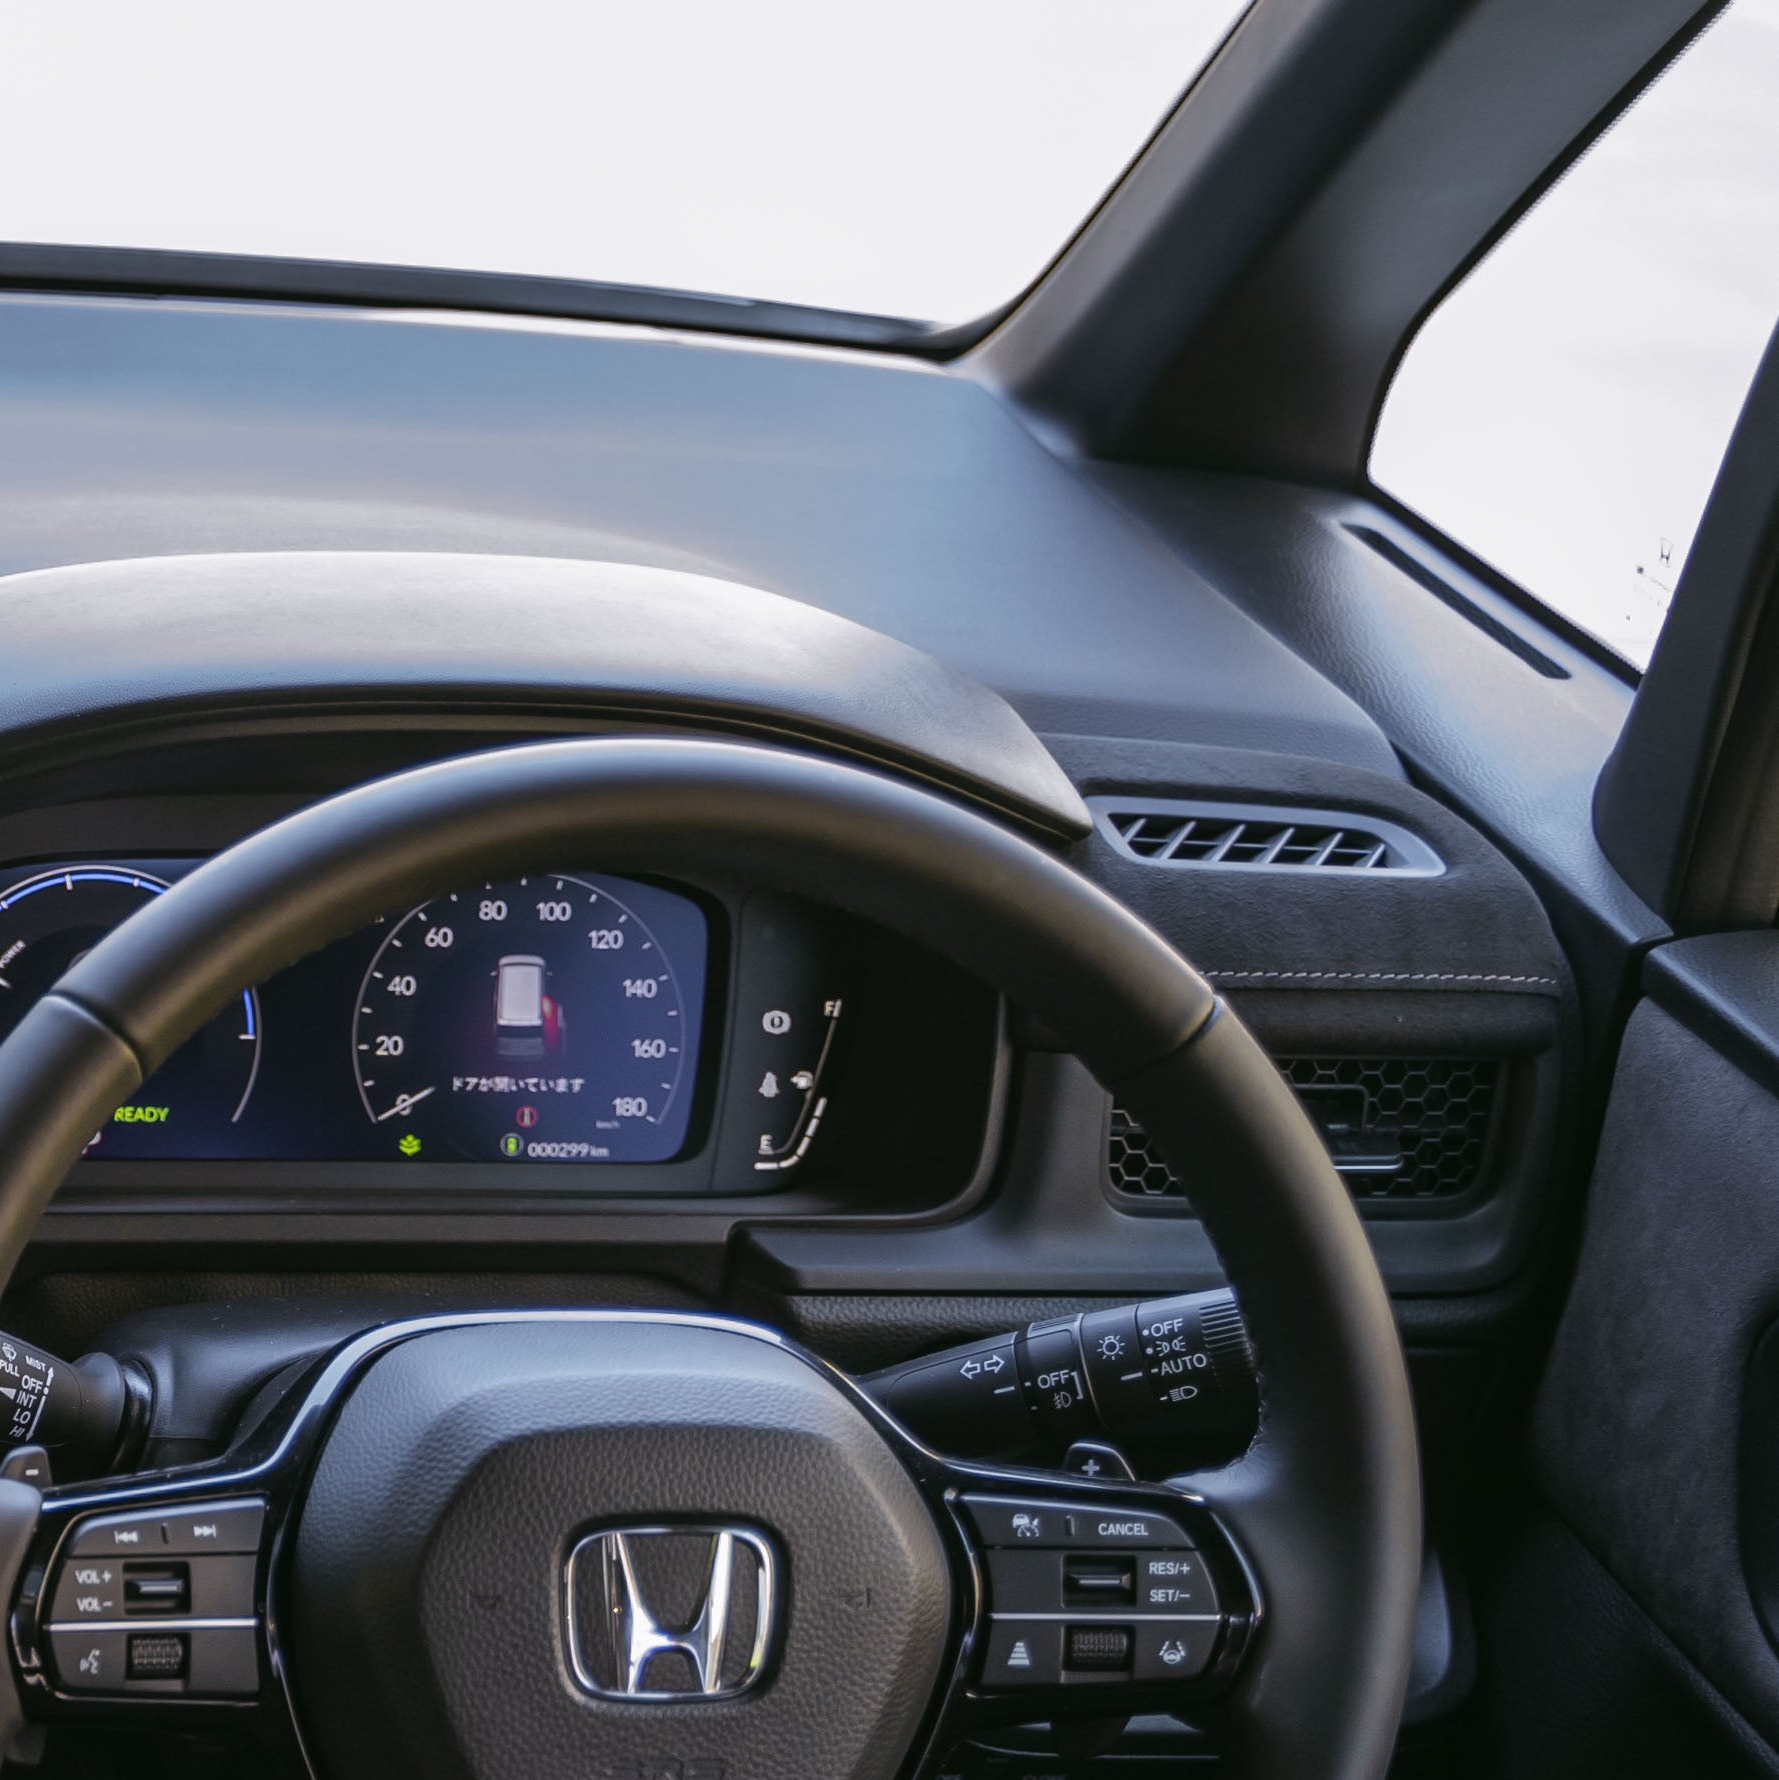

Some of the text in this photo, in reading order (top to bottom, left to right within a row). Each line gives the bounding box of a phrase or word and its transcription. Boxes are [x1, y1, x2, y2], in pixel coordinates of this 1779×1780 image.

[478, 900, 572, 922] 80 100
[424, 926, 624, 950] 60 120
[386, 975, 657, 999] 40 140
[375, 1035, 667, 1059] 20 160
[452, 1076, 586, 1094] ドアが開いています
[113, 1106, 169, 1123] READY
[612, 1097, 648, 1118] 180
[527, 1142, 609, 1158] 000299 km
[1150, 1319, 1184, 1337] OFF
[0, 1360, 20, 1377] PULL
[25, 1354, 46, 1371] MIST
[1160, 1354, 1208, 1376] AUTO
[21, 1374, 43, 1394] OFF
[1038, 1370, 1071, 1389] OFF
[16, 1392, 37, 1409] INT
[13, 1409, 29, 1424] LO
[8, 1424, 25, 1438] HI
[1098, 1522, 1149, 1536] CANCEL
